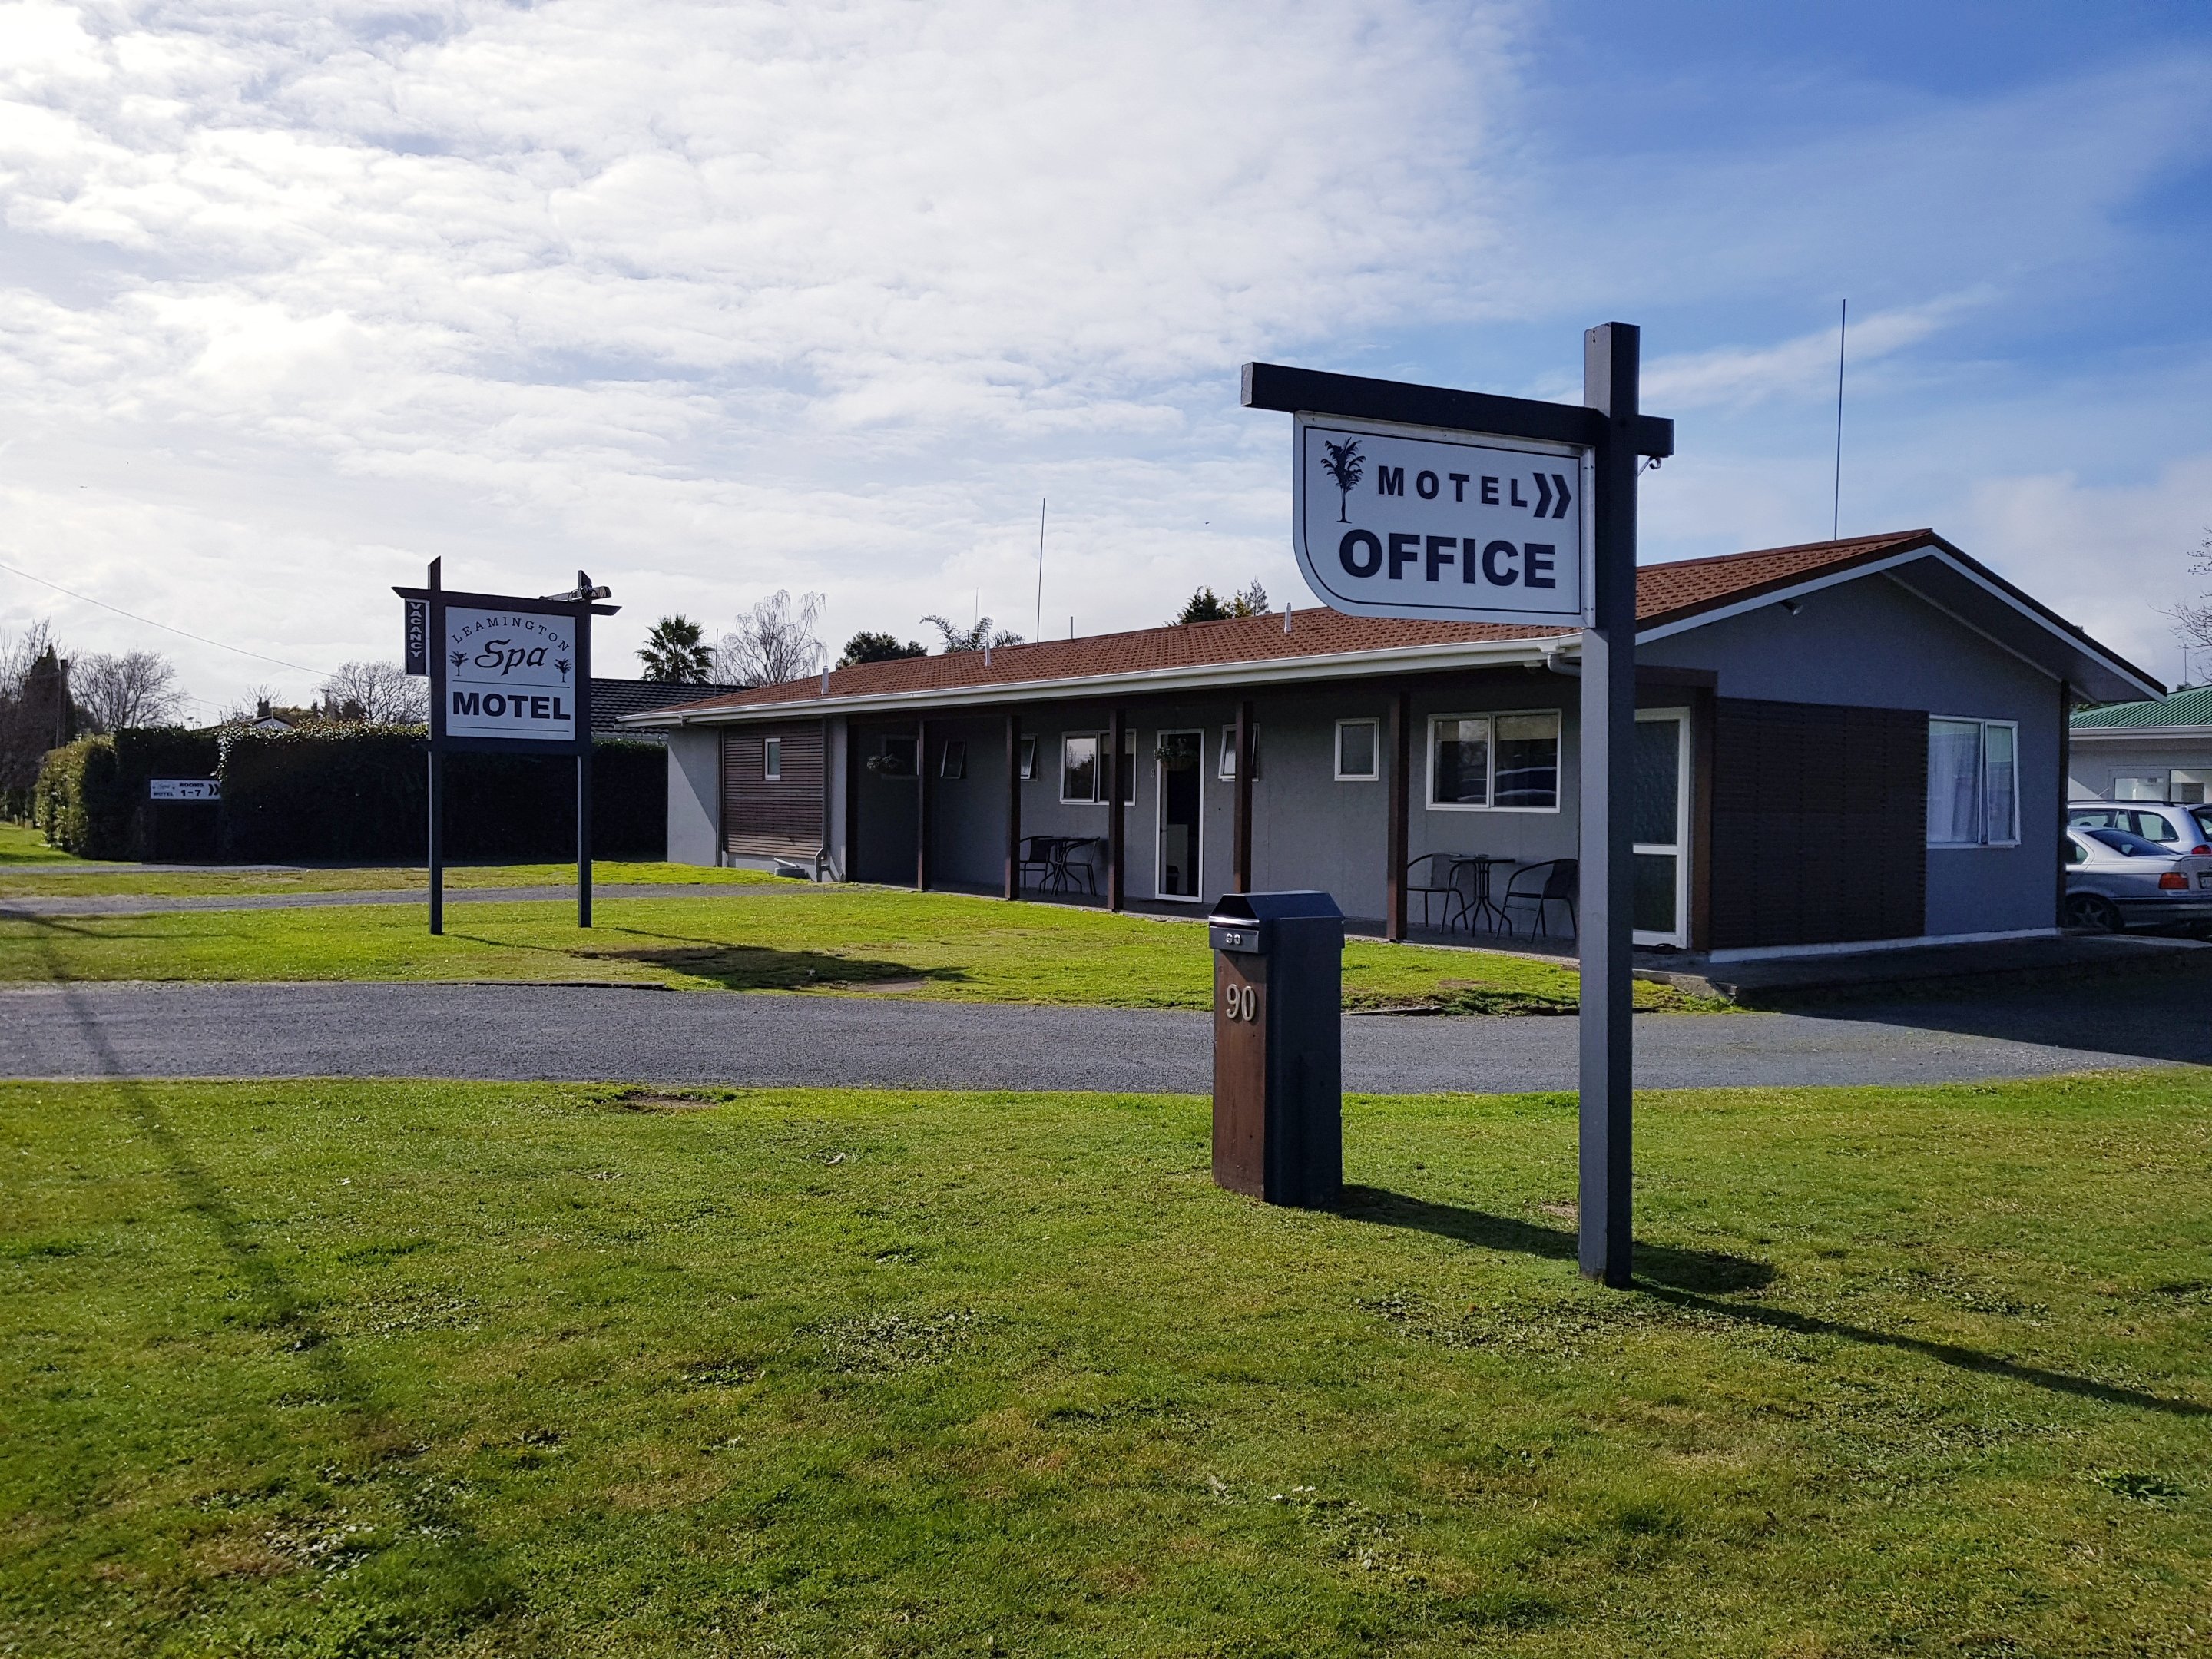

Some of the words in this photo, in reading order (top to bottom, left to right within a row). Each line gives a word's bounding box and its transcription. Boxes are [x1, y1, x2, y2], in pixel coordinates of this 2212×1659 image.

[1378, 465, 1528, 508] MOTEL
[1339, 528, 1556, 589] OFFICE
[409, 602, 422, 657] VACANCY
[452, 617, 570, 651] LEAMINGTON
[474, 639, 549, 676] Spa
[452, 691, 571, 720] MOTEL
[1226, 933, 1241, 945] 90
[1226, 984, 1255, 1021] 90
